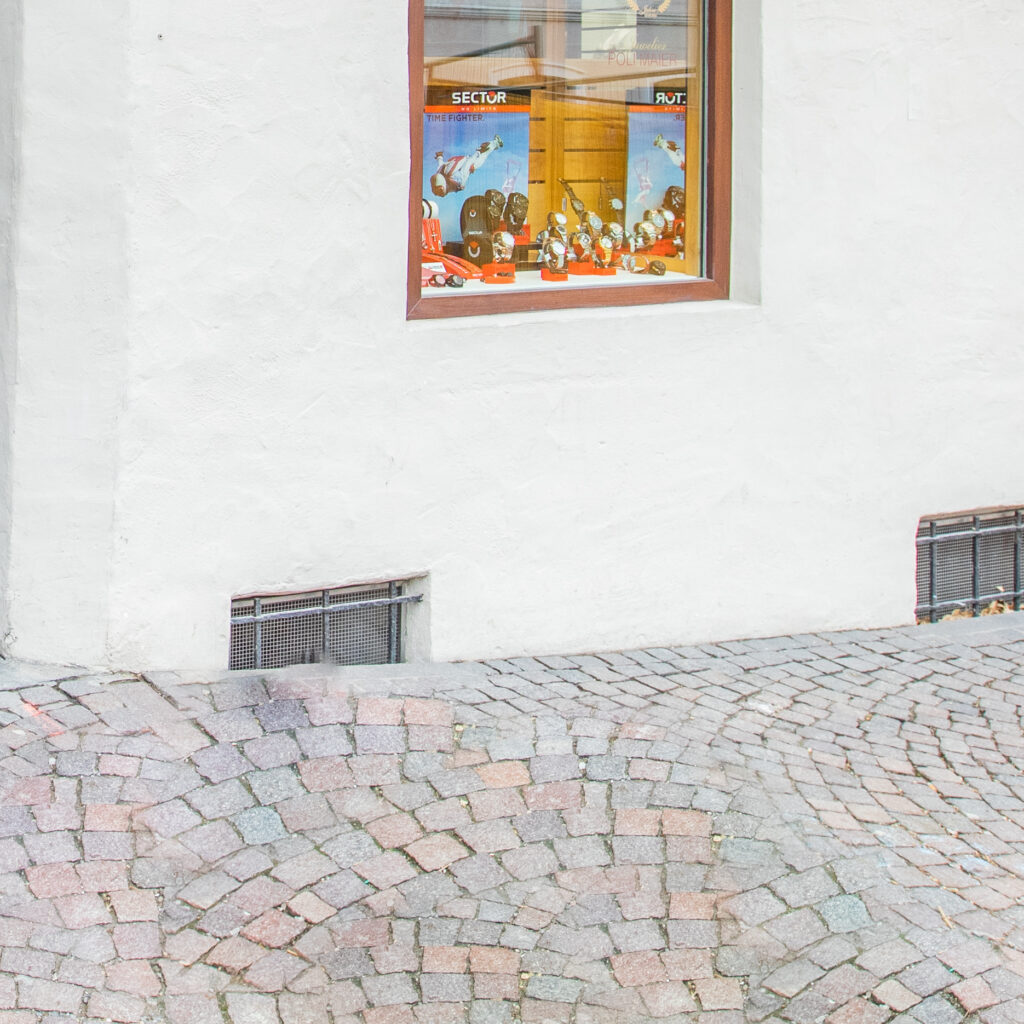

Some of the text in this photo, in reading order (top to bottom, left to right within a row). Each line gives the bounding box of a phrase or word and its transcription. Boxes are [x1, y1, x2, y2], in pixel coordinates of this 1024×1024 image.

[608, 49, 679, 67] POLI MAIER
[451, 91, 507, 104] SECTOR
[427, 114, 446, 122] TIME
